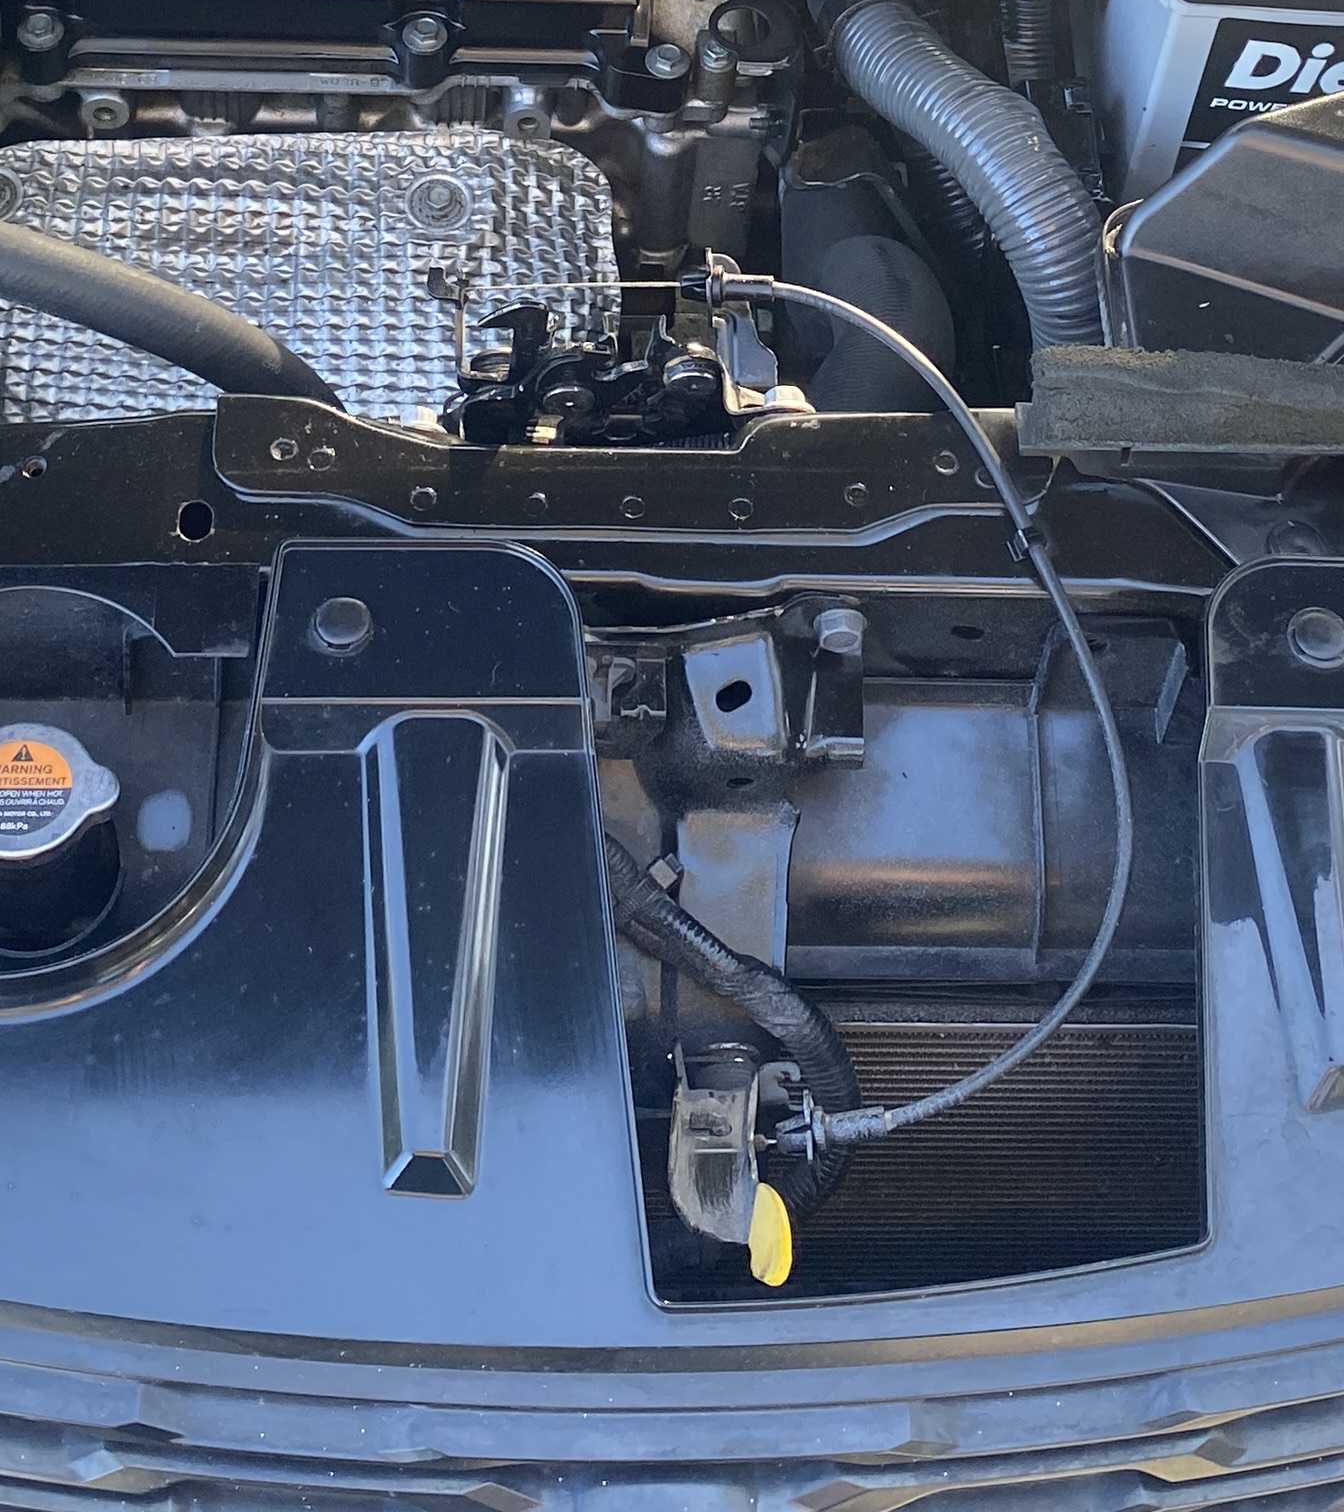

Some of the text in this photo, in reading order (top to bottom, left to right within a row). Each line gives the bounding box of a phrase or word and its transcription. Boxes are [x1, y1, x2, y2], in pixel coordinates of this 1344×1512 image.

[1209, 97, 1288, 112] POWE
[0, 790, 20, 798] OPEN
[22, 790, 46, 798] WHEN
